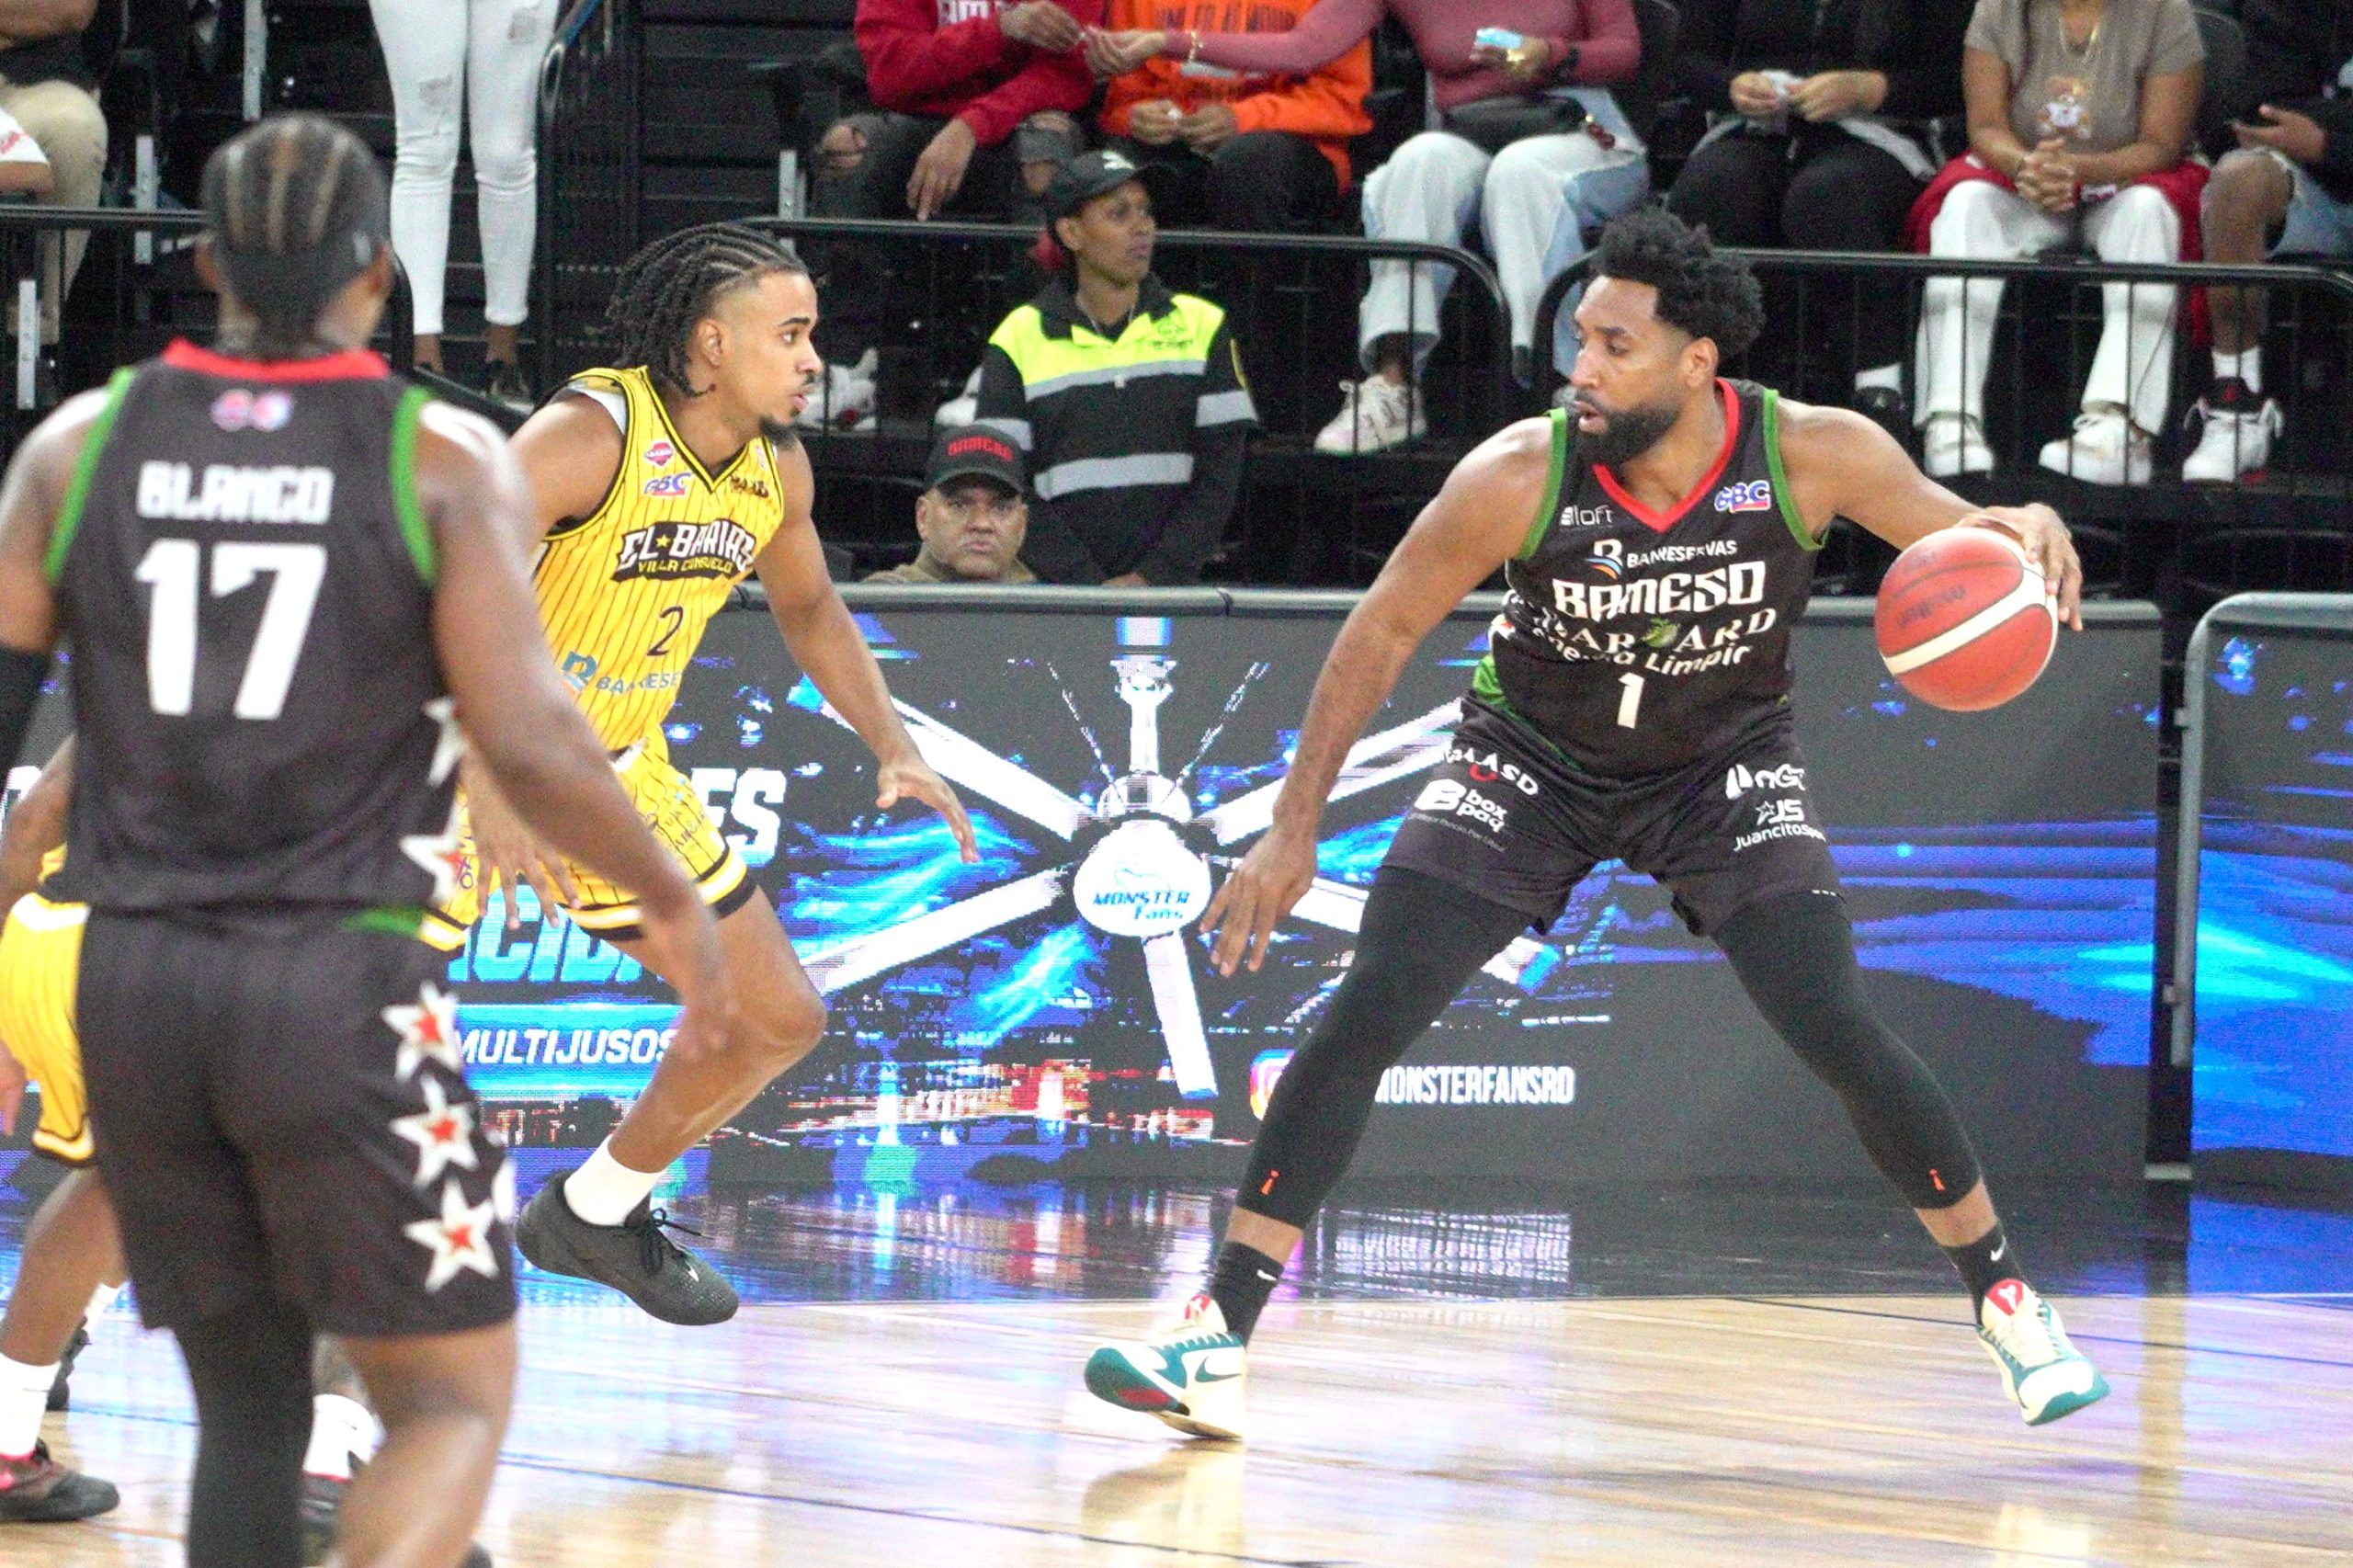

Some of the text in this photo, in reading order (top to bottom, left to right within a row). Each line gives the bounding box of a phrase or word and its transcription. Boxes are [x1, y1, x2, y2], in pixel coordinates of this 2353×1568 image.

[137, 460, 335, 525] BLANCO
[617, 526, 659, 571] EL
[134, 538, 327, 720] 17
[646, 605, 684, 656] 2
[1617, 672, 1644, 730] 1
[1465, 789, 1508, 821] box
[1768, 798, 1805, 824] JS
[1092, 889, 1191, 905] MONSTER
